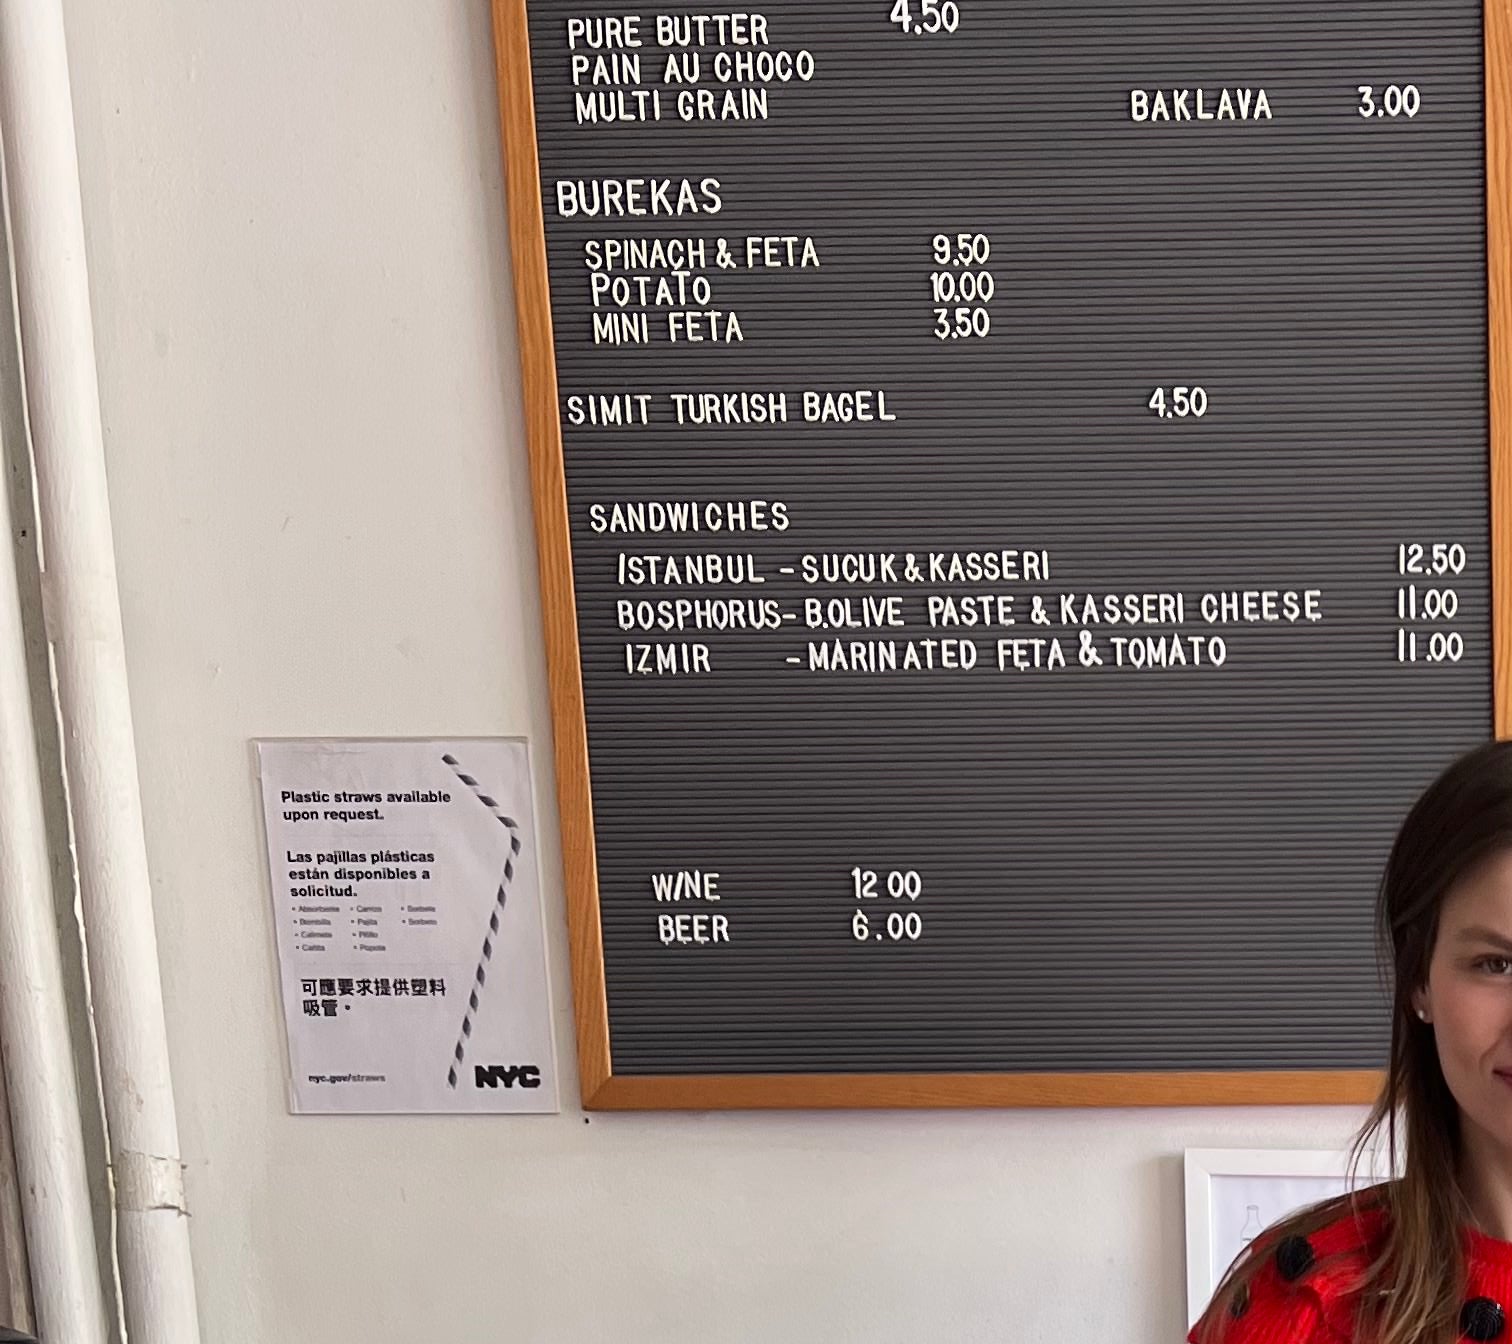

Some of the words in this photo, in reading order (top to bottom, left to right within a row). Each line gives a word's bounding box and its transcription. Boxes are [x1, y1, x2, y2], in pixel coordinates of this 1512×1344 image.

[567, 15, 643, 50] PURE
[656, 13, 769, 47] BUTTER
[890, 0, 959, 35] 4.50
[572, 53, 641, 86] PAIN
[663, 52, 700, 84] AU
[714, 50, 815, 83] CHOCO
[575, 89, 661, 125] MULTI
[677, 87, 768, 122] GRAIN
[1131, 88, 1273, 122] BAKLAVA
[1358, 84, 1421, 118] 3.00
[556, 178, 722, 218] BUREKAS
[585, 238, 706, 272] SPINACH
[716, 238, 737, 269] &
[746, 236, 820, 269] FETA
[933, 233, 990, 267] 9.50
[590, 270, 711, 307] POTATO
[930, 271, 995, 303] 10.00
[592, 312, 649, 346] MINI
[668, 309, 744, 344] FETA
[933, 307, 990, 340] 3.50
[567, 394, 652, 426] SIMIT
[670, 392, 787, 425] TURKISH
[803, 390, 897, 423] BAGEL
[1149, 386, 1208, 419] 4.50
[590, 500, 790, 533] SANDWICHES
[618, 552, 765, 585] ISTANBUL
[1399, 543, 1466, 576] 12.50
[927, 595, 1015, 628] PASTE
[1030, 595, 1051, 626] &
[1060, 592, 1184, 625] KASSERI
[1201, 589, 1322, 624] CHEESE
[1398, 584, 1458, 620] 11.00
[626, 643, 711, 675] IZMIR
[997, 638, 1066, 672] FETA
[1078, 629, 1103, 667] &
[1109, 632, 1227, 669] TOMATO
[1398, 627, 1464, 662] 11.00
[281, 790, 330, 804] Plastic
[334, 791, 383, 803] straws
[386, 790, 451, 803] available
[282, 810, 319, 823] upon
[323, 808, 385, 823] request.
[286, 850, 313, 863] Las
[316, 850, 367, 866] pajillas
[370, 849, 435, 865] plásticas
[288, 867, 330, 880] están
[333, 867, 418, 883] disponibles
[421, 870, 431, 880] a
[290, 884, 358, 897] solicitud.
[658, 914, 730, 945] BEER
[852, 909, 922, 941] 6.00
[474, 1065, 541, 1089] NYC
